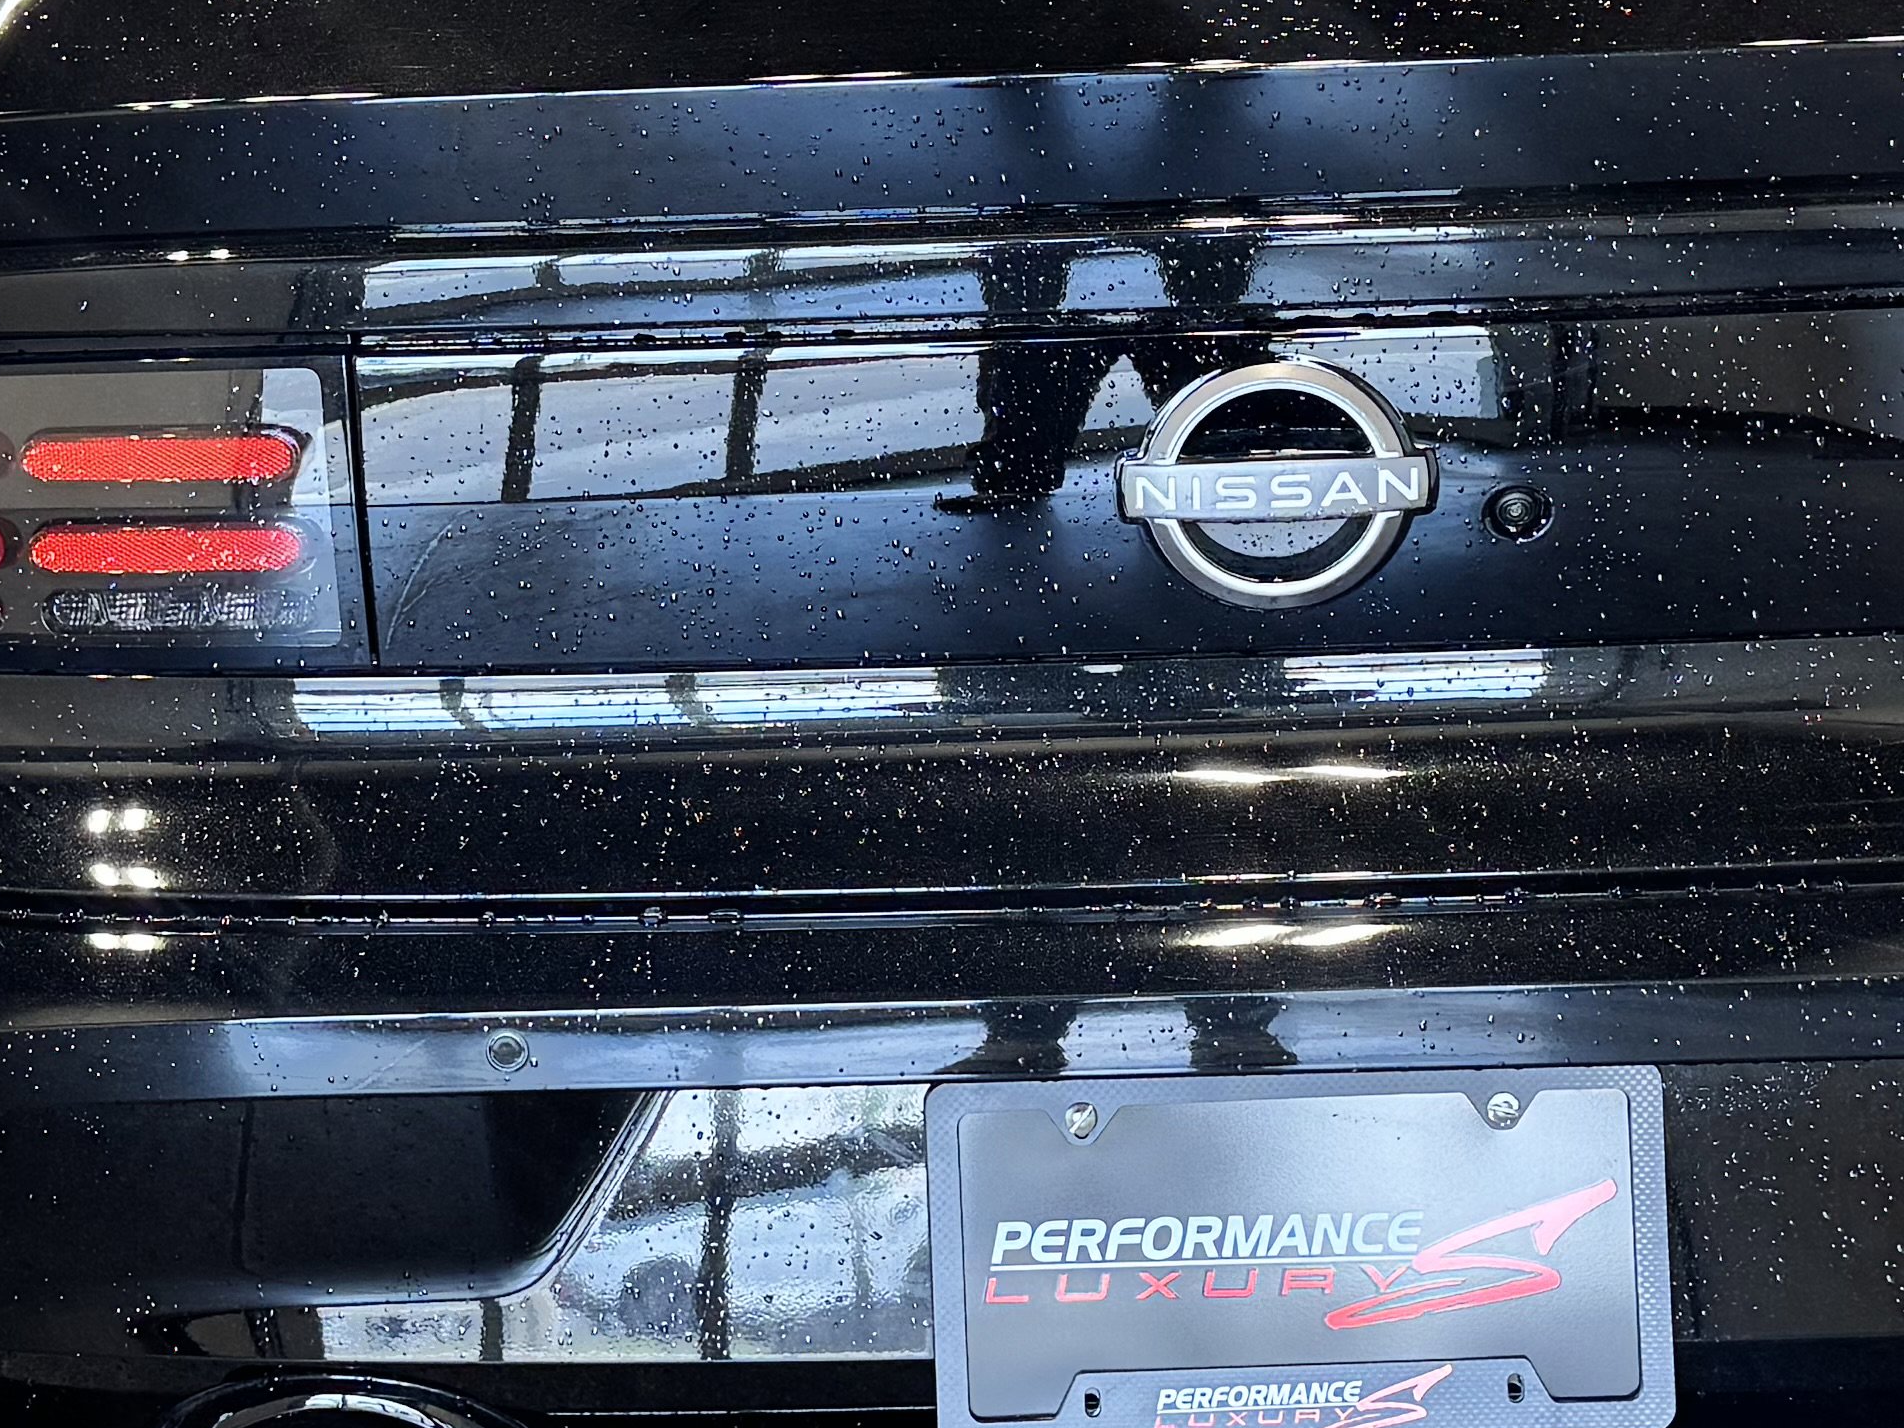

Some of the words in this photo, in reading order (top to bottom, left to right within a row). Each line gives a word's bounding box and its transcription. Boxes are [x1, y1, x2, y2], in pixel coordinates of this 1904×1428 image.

[1134, 466, 1419, 512] NISSAN
[990, 1210, 1424, 1265] PERFORMANCE
[984, 1264, 1413, 1305] LUXURY
[1156, 1379, 1363, 1411] PERFORMANCE
